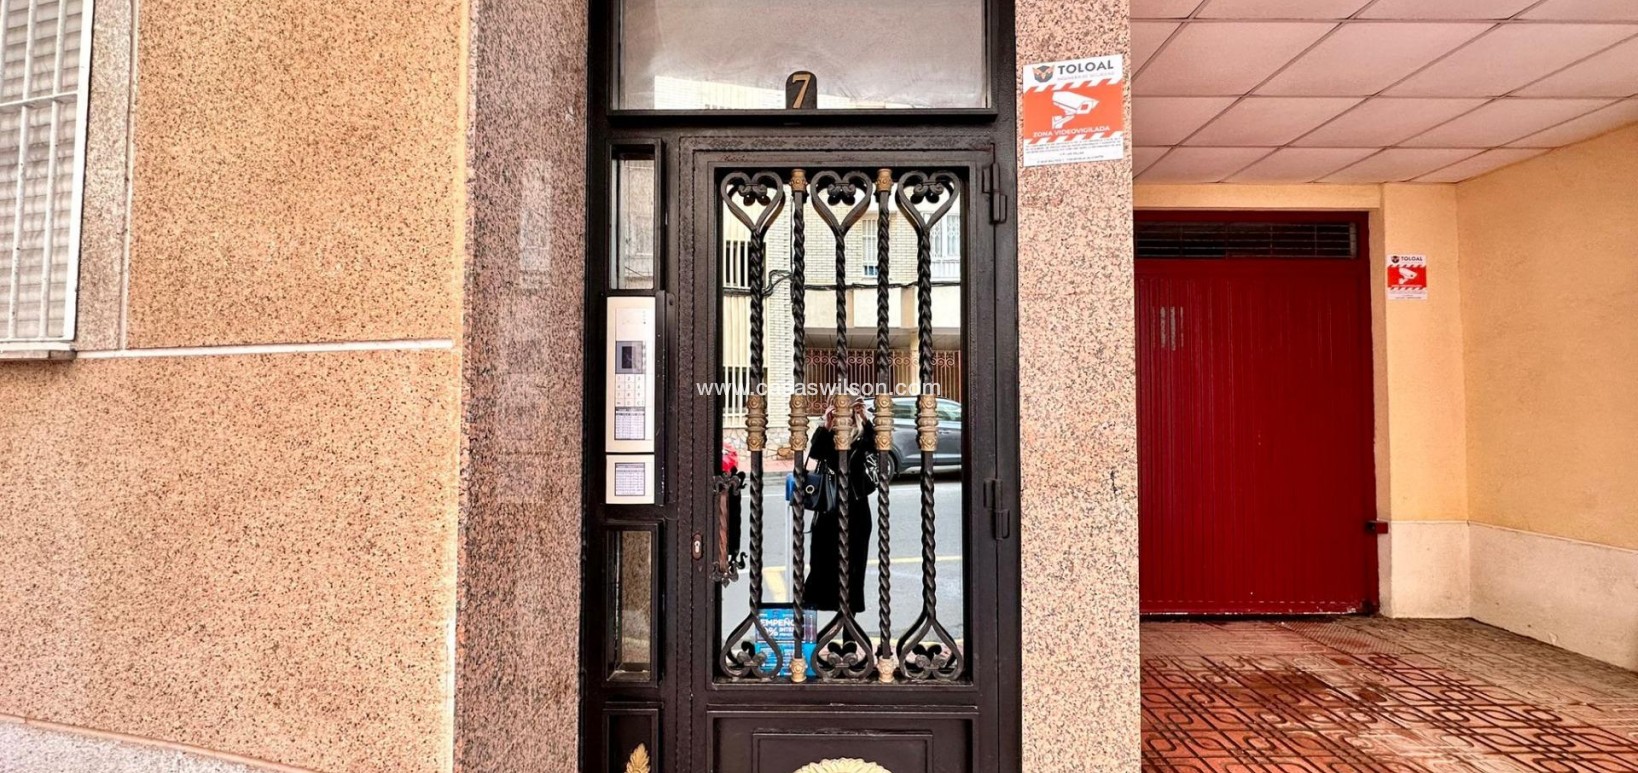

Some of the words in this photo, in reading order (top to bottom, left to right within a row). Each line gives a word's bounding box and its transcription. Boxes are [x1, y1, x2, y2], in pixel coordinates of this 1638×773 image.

[1058, 60, 1114, 75] TOLOAL
[791, 73, 811, 109] 7
[1055, 126, 1110, 136] VIDEOVIGILADA
